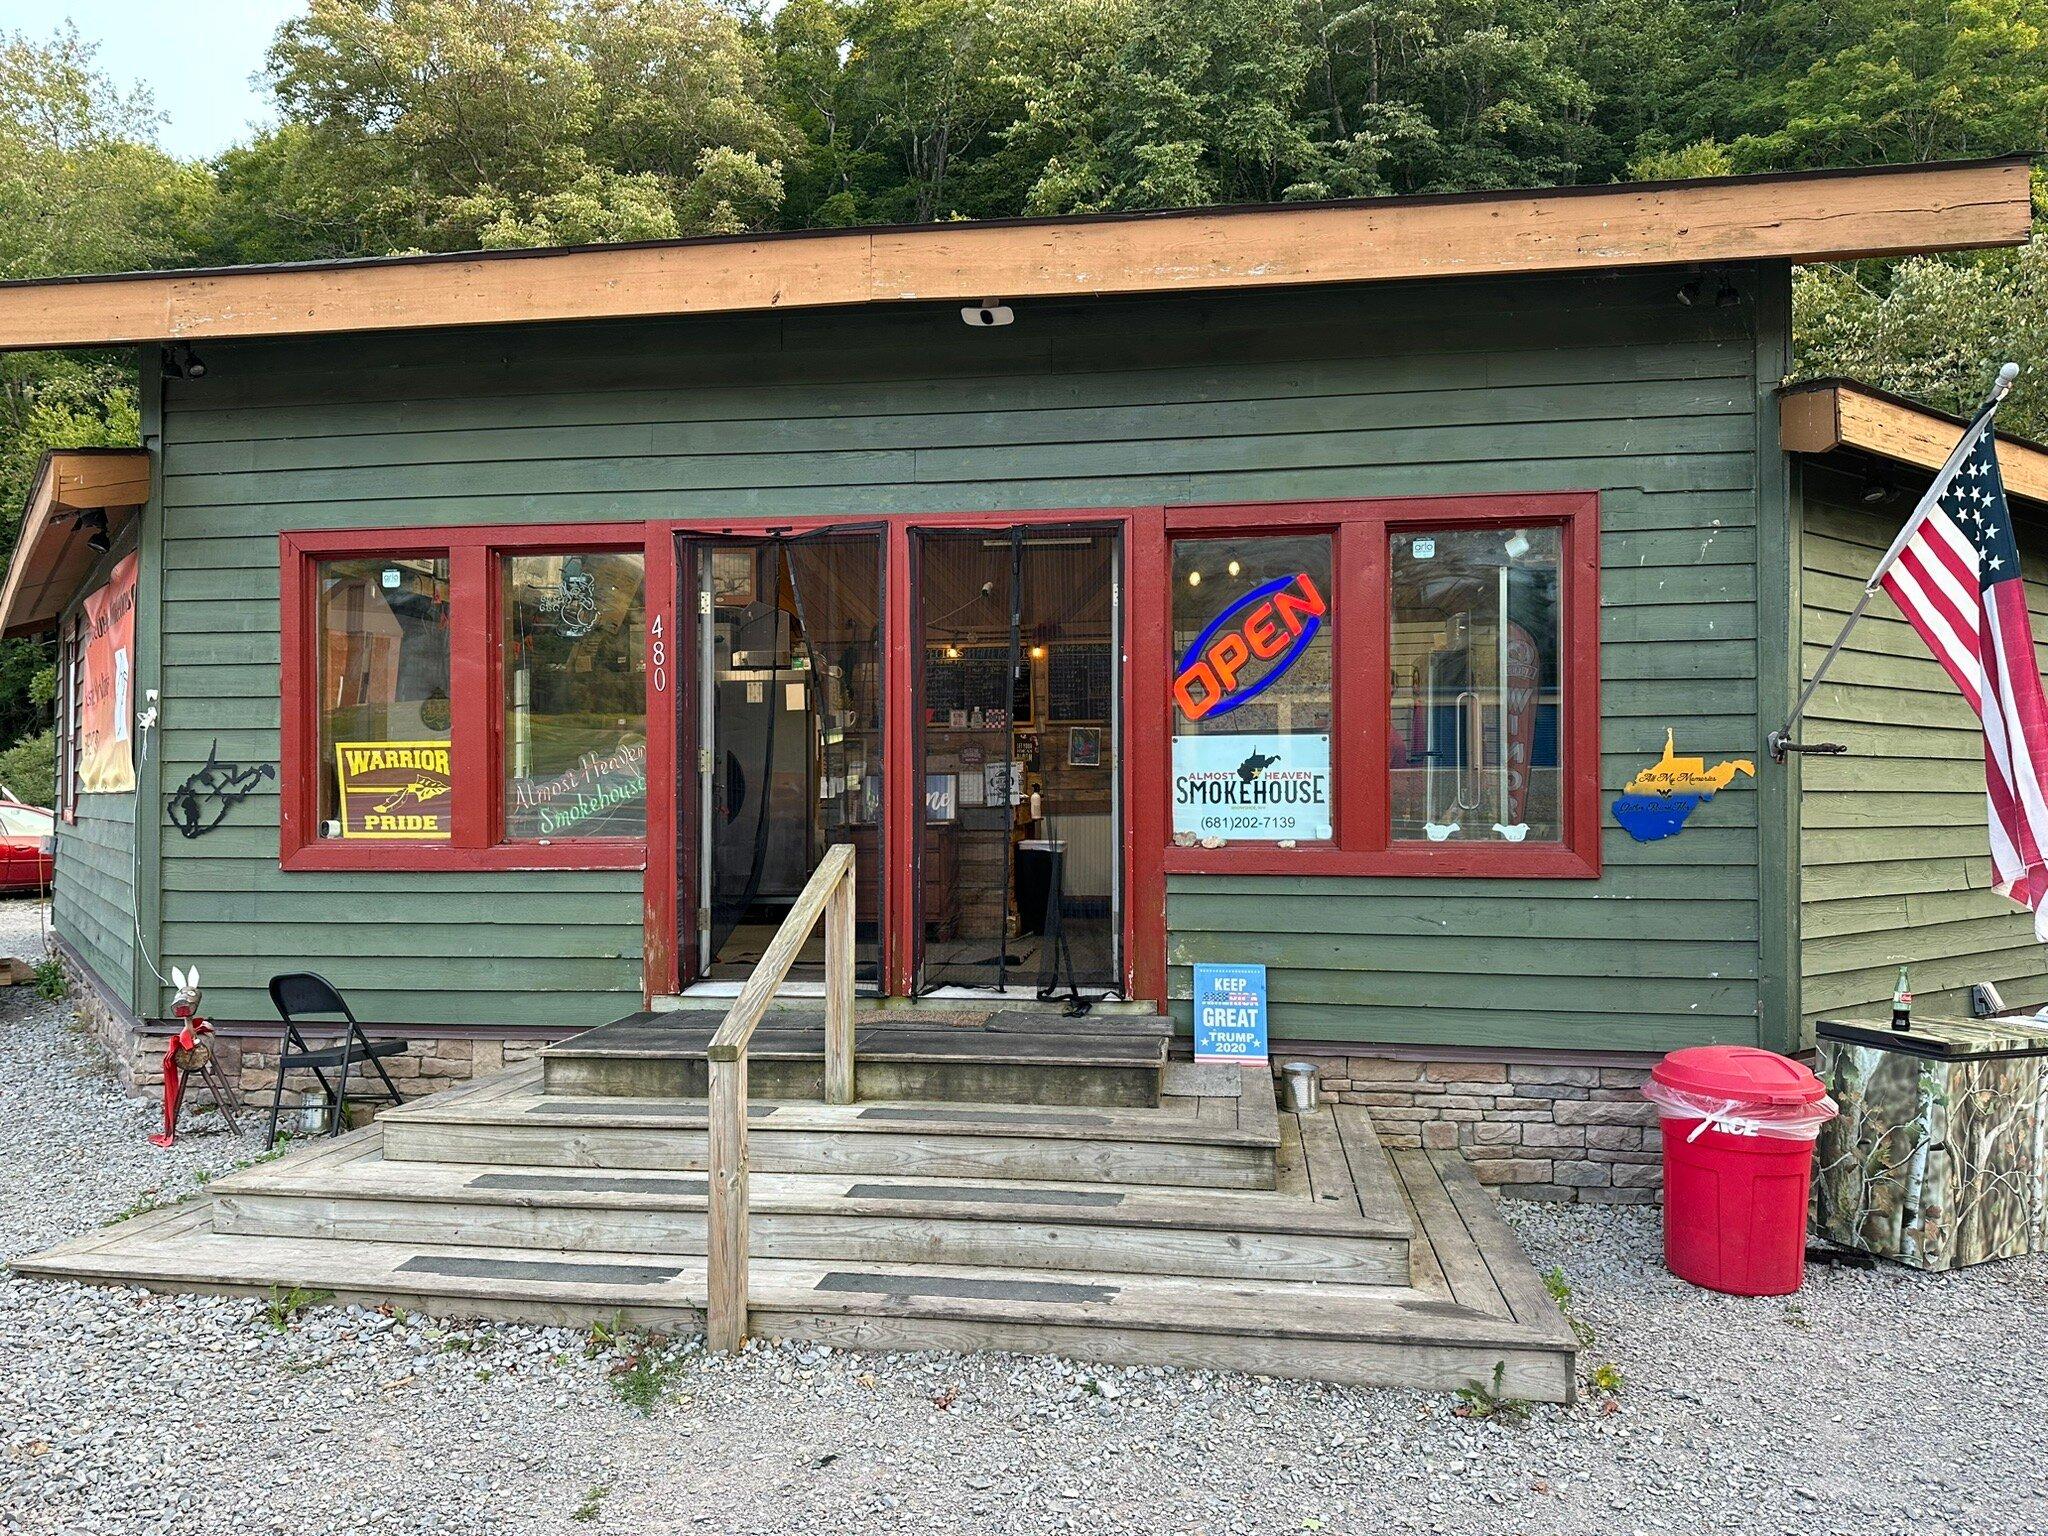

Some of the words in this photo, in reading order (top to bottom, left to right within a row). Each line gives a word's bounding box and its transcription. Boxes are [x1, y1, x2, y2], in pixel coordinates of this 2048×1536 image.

[1415, 542, 1433, 550] arlo
[652, 614, 666, 692] 480
[1174, 573, 1326, 720] OPEN
[345, 750, 450, 776] WARRIOR
[514, 769, 579, 815] Almost
[581, 744, 646, 783] Heaven
[1188, 772, 1236, 780] ALMOST
[1264, 771, 1312, 780] HEAVEN
[1639, 773, 1655, 783] All
[1657, 773, 1675, 785] My
[1677, 772, 1718, 785] Memories
[1176, 775, 1325, 804] SMOKEHOUSE
[540, 776, 646, 834] Smokehouse
[364, 815, 438, 831] PRIDE
[1201, 816, 1296, 830] (681)202-7139
[1214, 977, 1247, 991] KEEP
[1202, 992, 1259, 1006] AMERICA
[1203, 1007, 1258, 1028] GREAT
[1209, 1032, 1255, 1042] TRUMP
[1215, 1043, 1247, 1053] 2020
[1711, 1117, 1760, 1137] ACE
